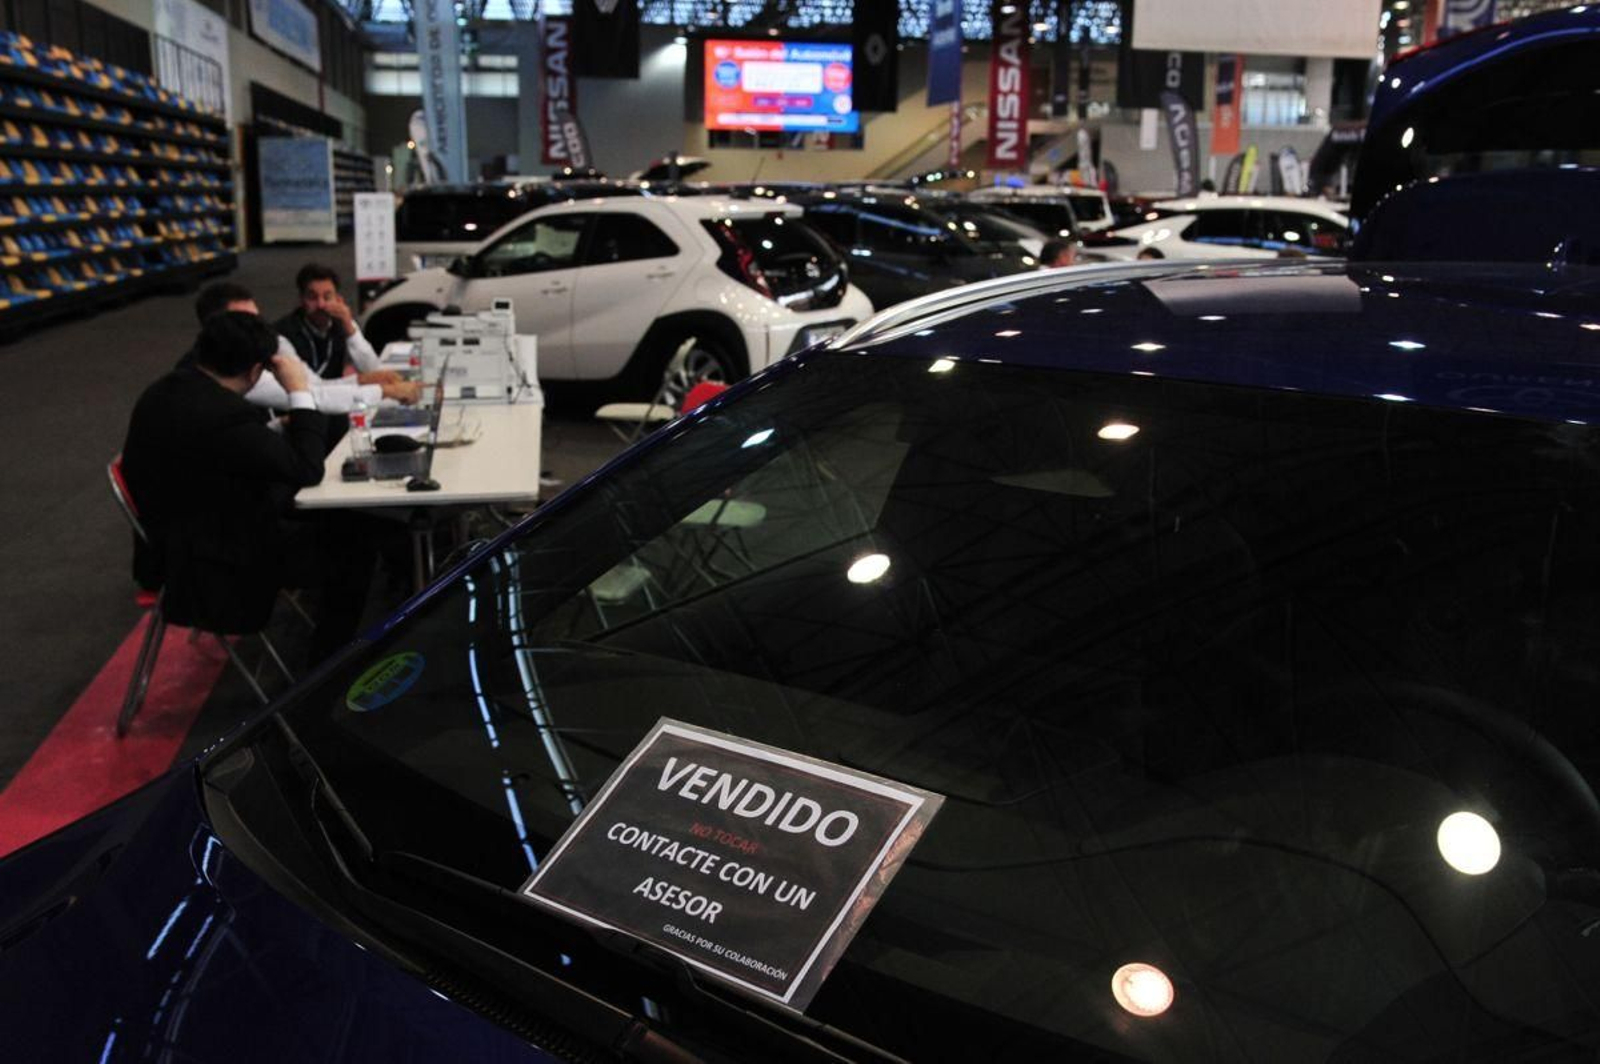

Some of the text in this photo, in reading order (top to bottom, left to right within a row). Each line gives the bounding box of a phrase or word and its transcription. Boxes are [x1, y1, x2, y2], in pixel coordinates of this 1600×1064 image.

[995, 12, 1023, 161] NISSAN
[657, 757, 859, 847] VENDIDO
[689, 822, 759, 854] NO TOCAR
[607, 822, 816, 911] CONTACTE CON UN
[633, 876, 723, 924] ASESOR
[663, 923, 788, 981] GRACIAS POR SU COLABORACIÓN
